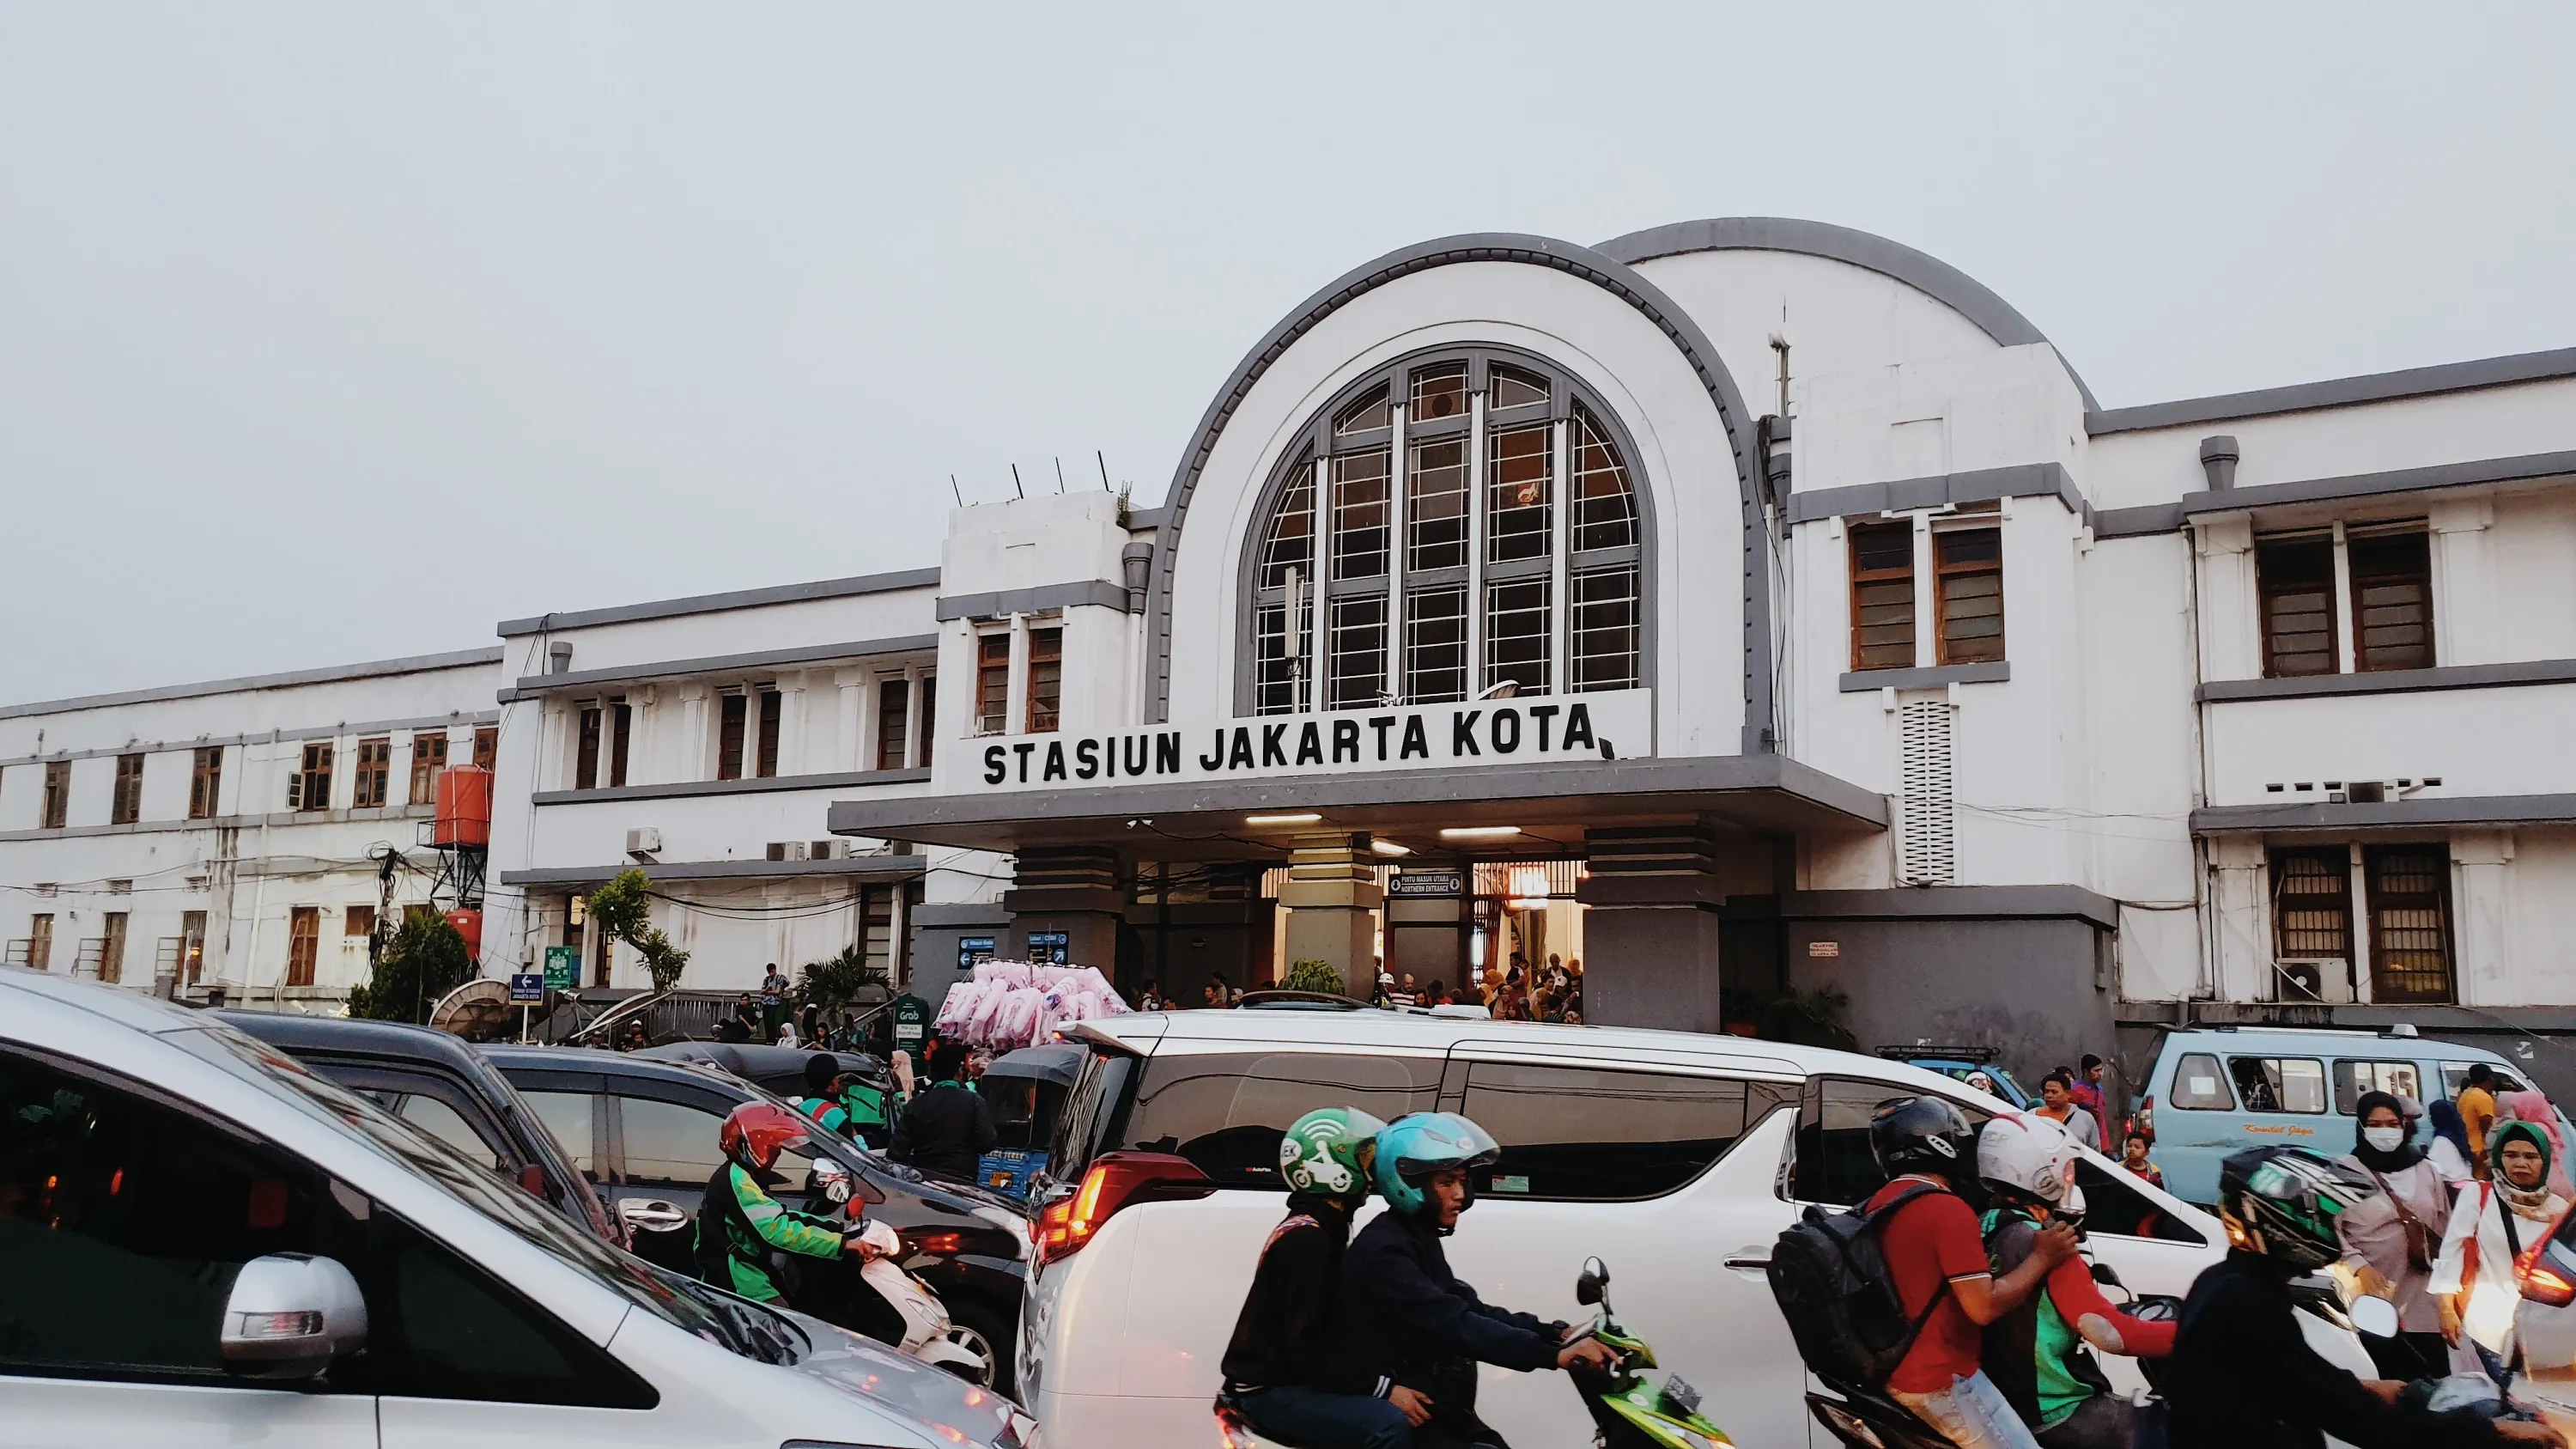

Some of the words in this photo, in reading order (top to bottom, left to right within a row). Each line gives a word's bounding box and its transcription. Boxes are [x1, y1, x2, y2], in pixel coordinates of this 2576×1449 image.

[983, 732, 1181, 785] STASIUN
[1199, 715, 1429, 771] JAKARTA
[1453, 703, 1595, 757] KOTA
[900, 1010, 919, 1020] Grab
